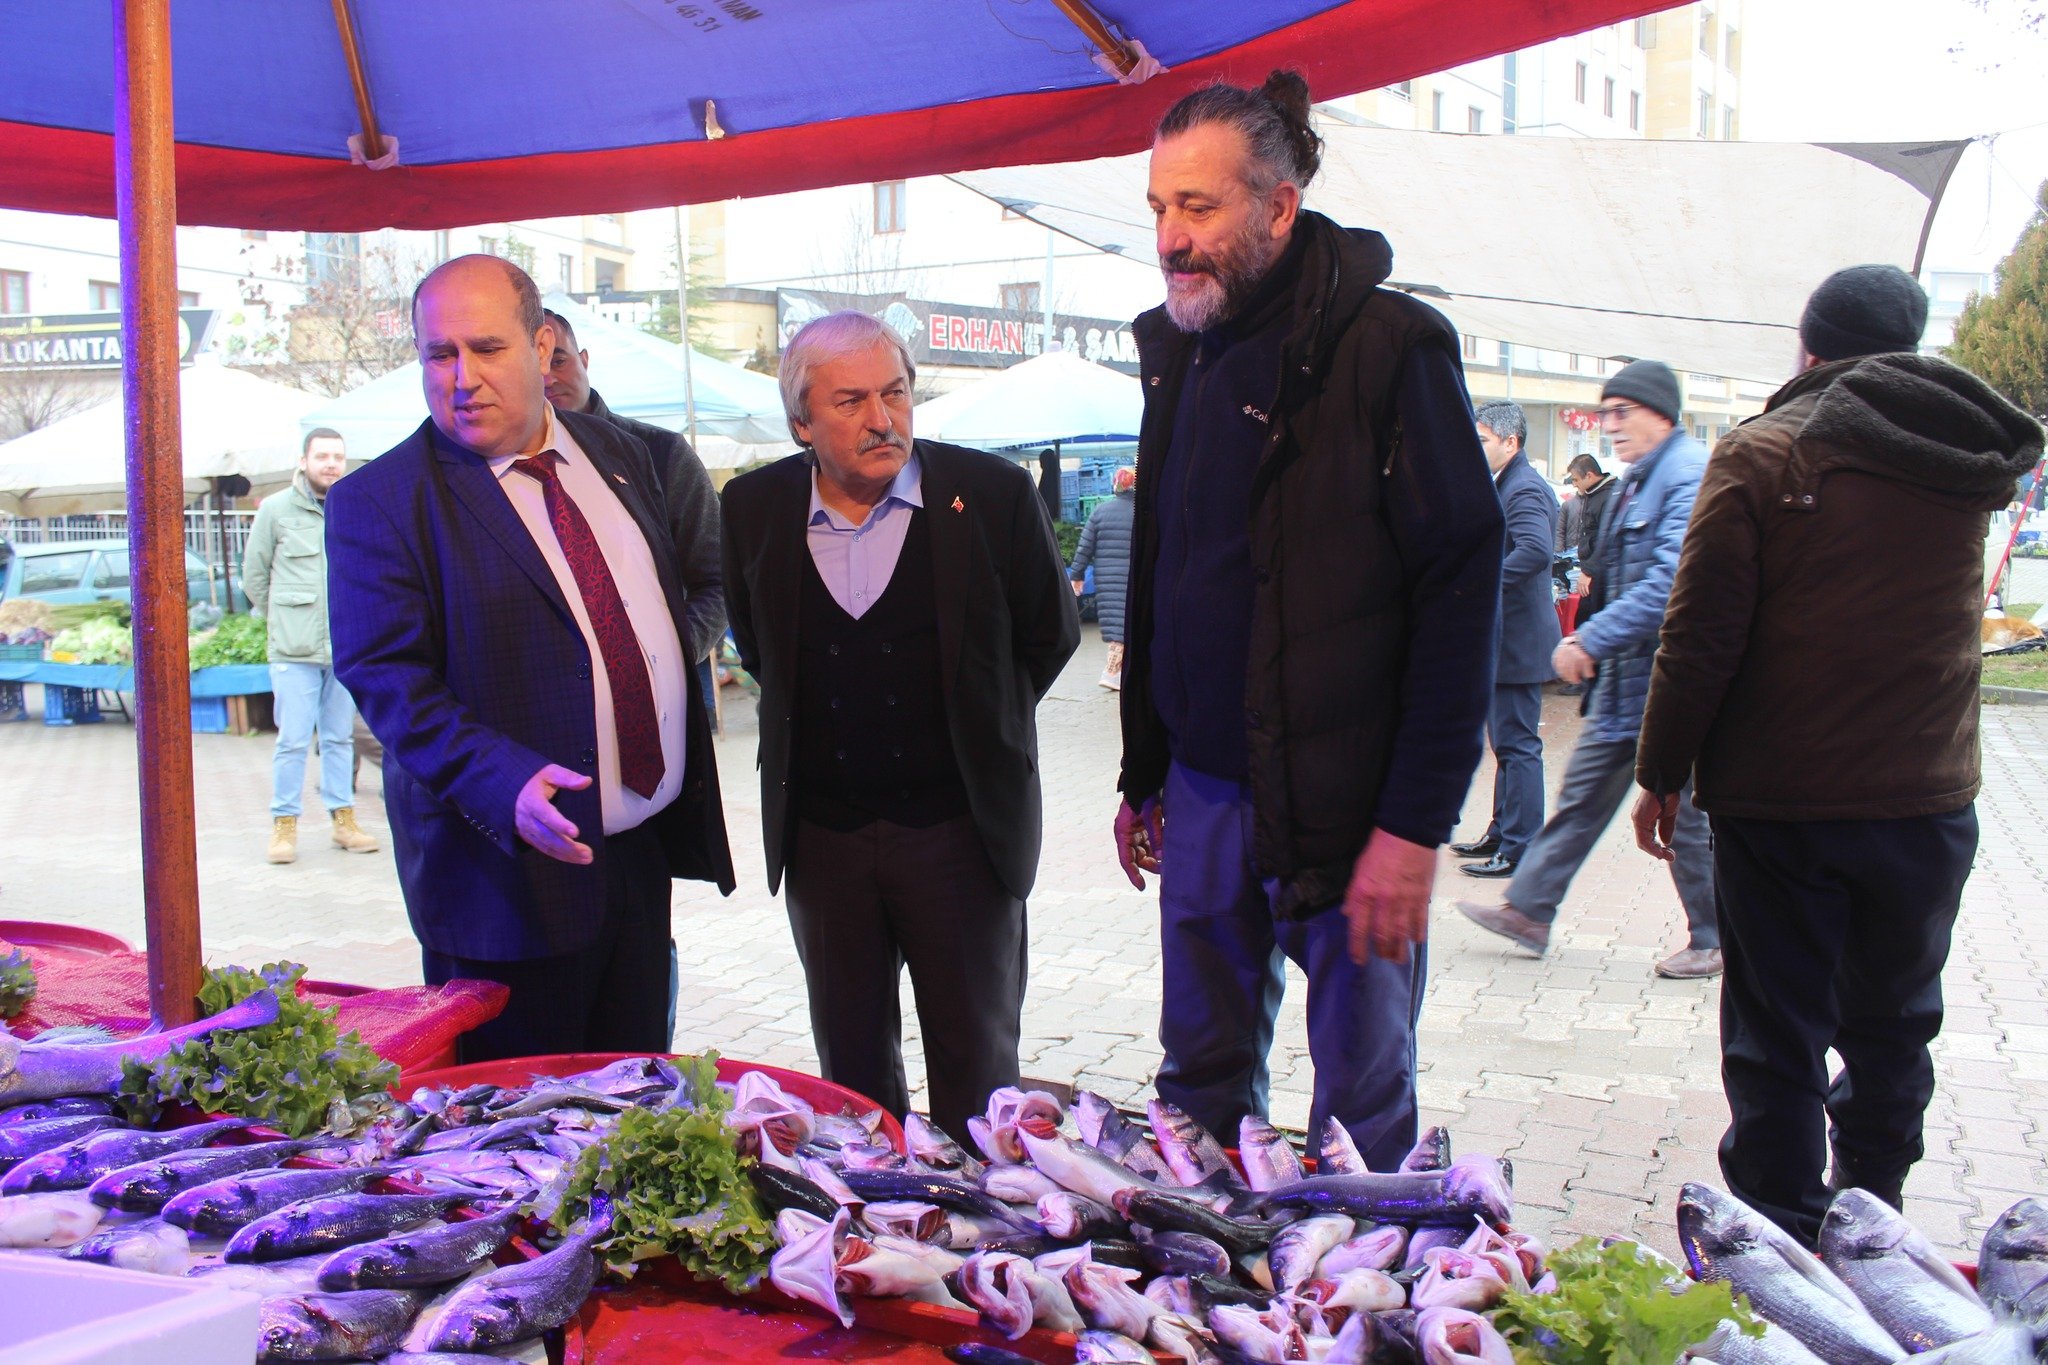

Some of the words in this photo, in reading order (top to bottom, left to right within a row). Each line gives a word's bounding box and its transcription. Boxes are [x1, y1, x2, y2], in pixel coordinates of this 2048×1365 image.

[714, 0, 763, 22] MAN
[929, 314, 1023, 355] ERHAN
[1252, 409, 1269, 424] Col
